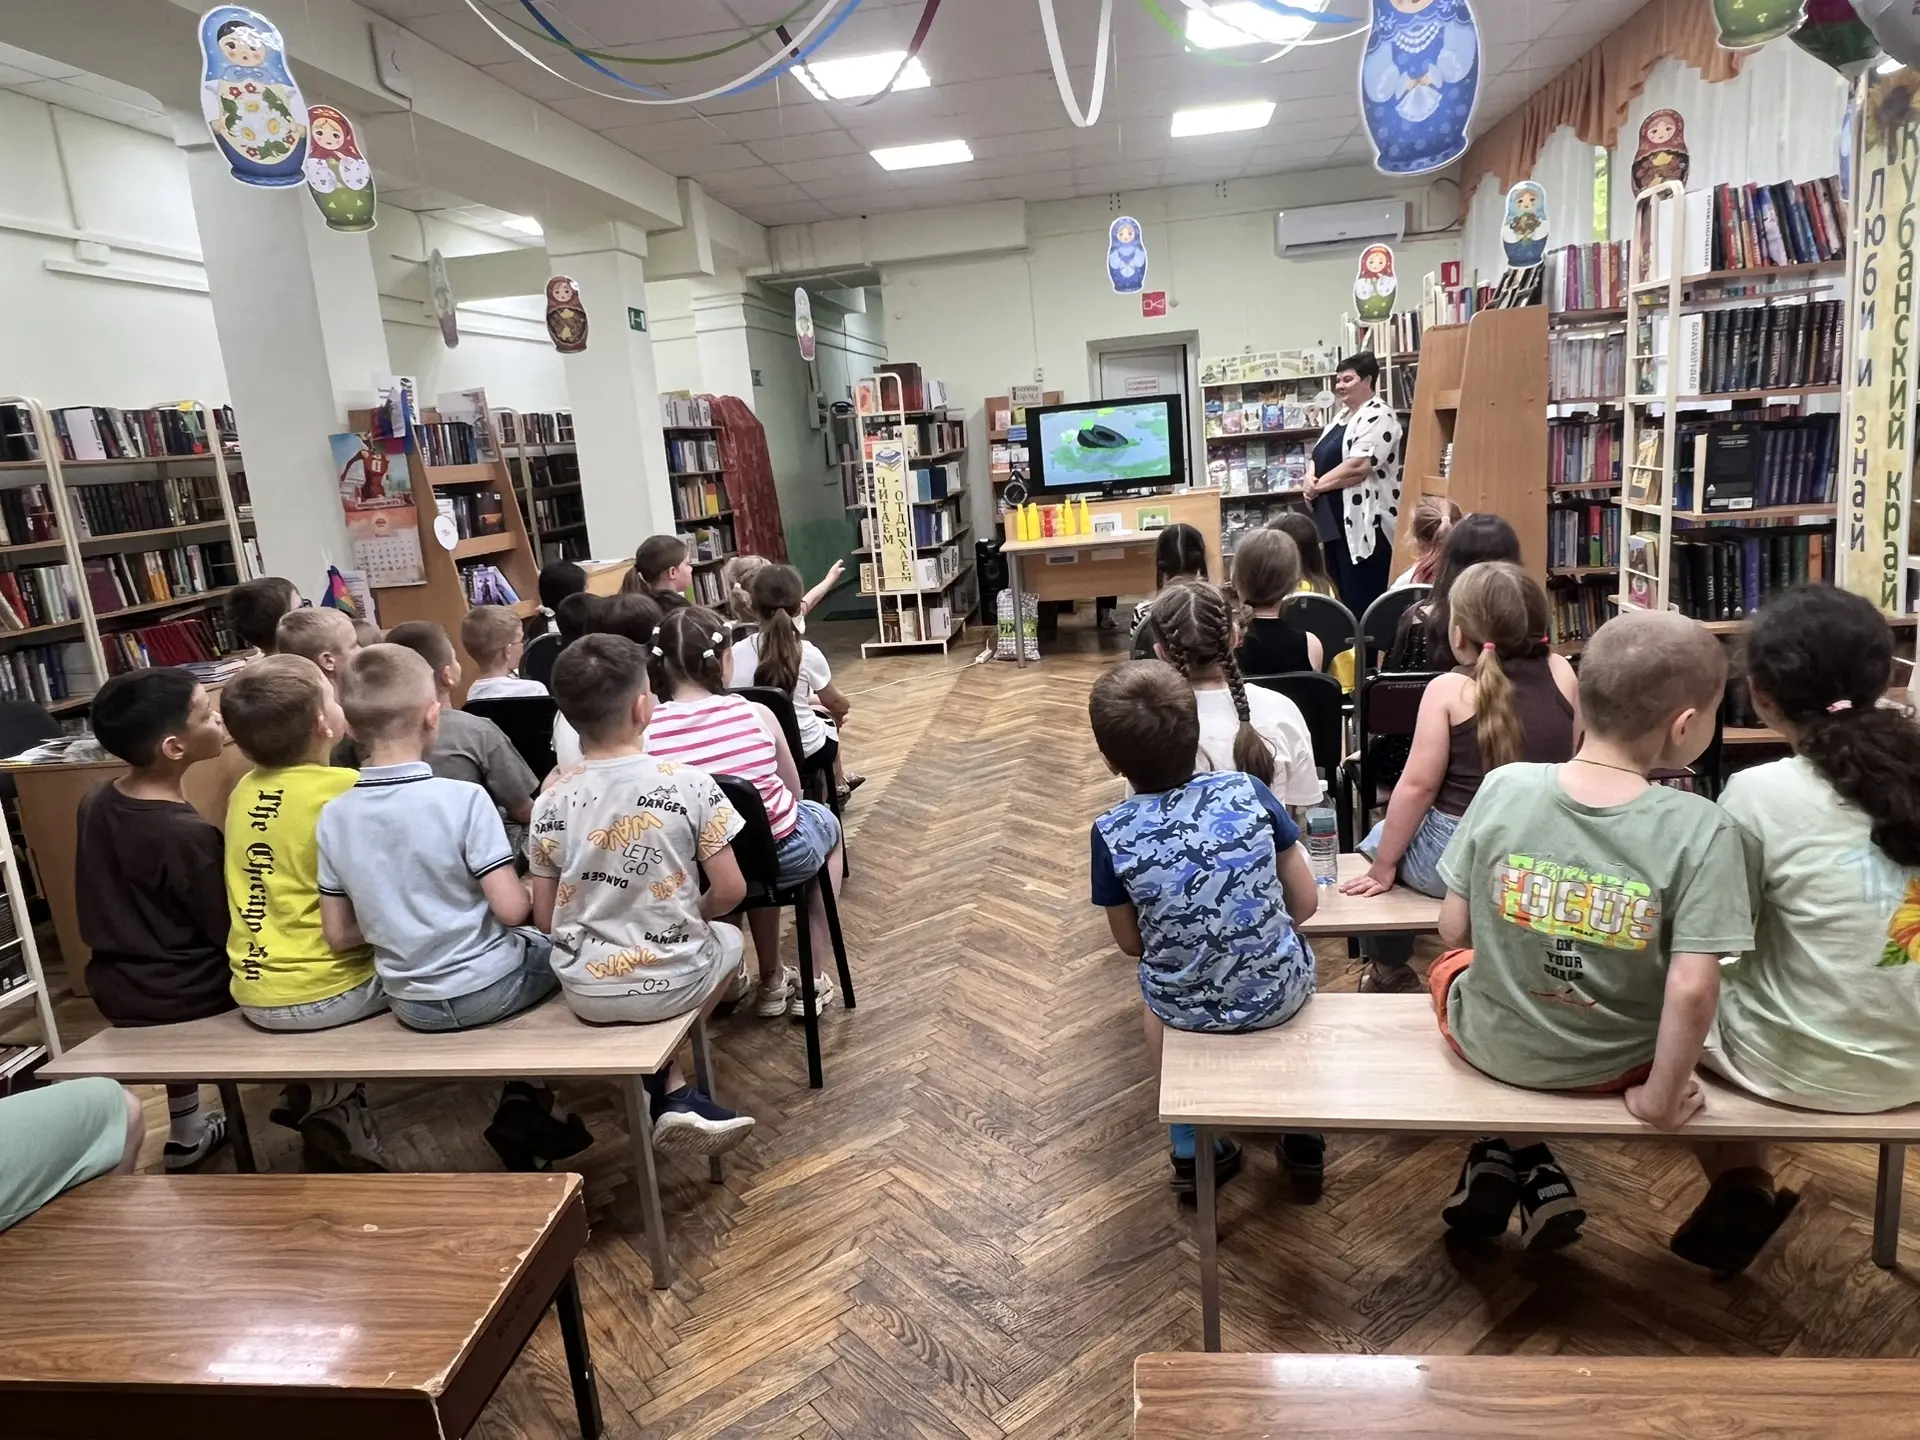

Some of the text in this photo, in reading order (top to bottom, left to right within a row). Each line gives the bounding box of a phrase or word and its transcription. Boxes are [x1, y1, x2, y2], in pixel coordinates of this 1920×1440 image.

[1850, 414, 1869, 552] знай
[876, 476, 894, 545] ЧИТАЕМ
[894, 490, 912, 583] ОТДЫХАЕМ
[1881, 470, 1902, 611] край
[247, 788, 285, 833] The
[636, 794, 688, 816] DANGER
[586, 810, 664, 852] WAVE
[622, 843, 664, 865] LET'S
[622, 860, 649, 876] GO
[240, 842, 275, 934] Chicago
[580, 871, 629, 890] DANGER
[1492, 862, 1662, 940] FOCUS
[643, 931, 690, 945] DANGER
[1556, 938, 1574, 951] ON
[584, 945, 661, 980] WAVE
[1544, 950, 1583, 968] YOUR
